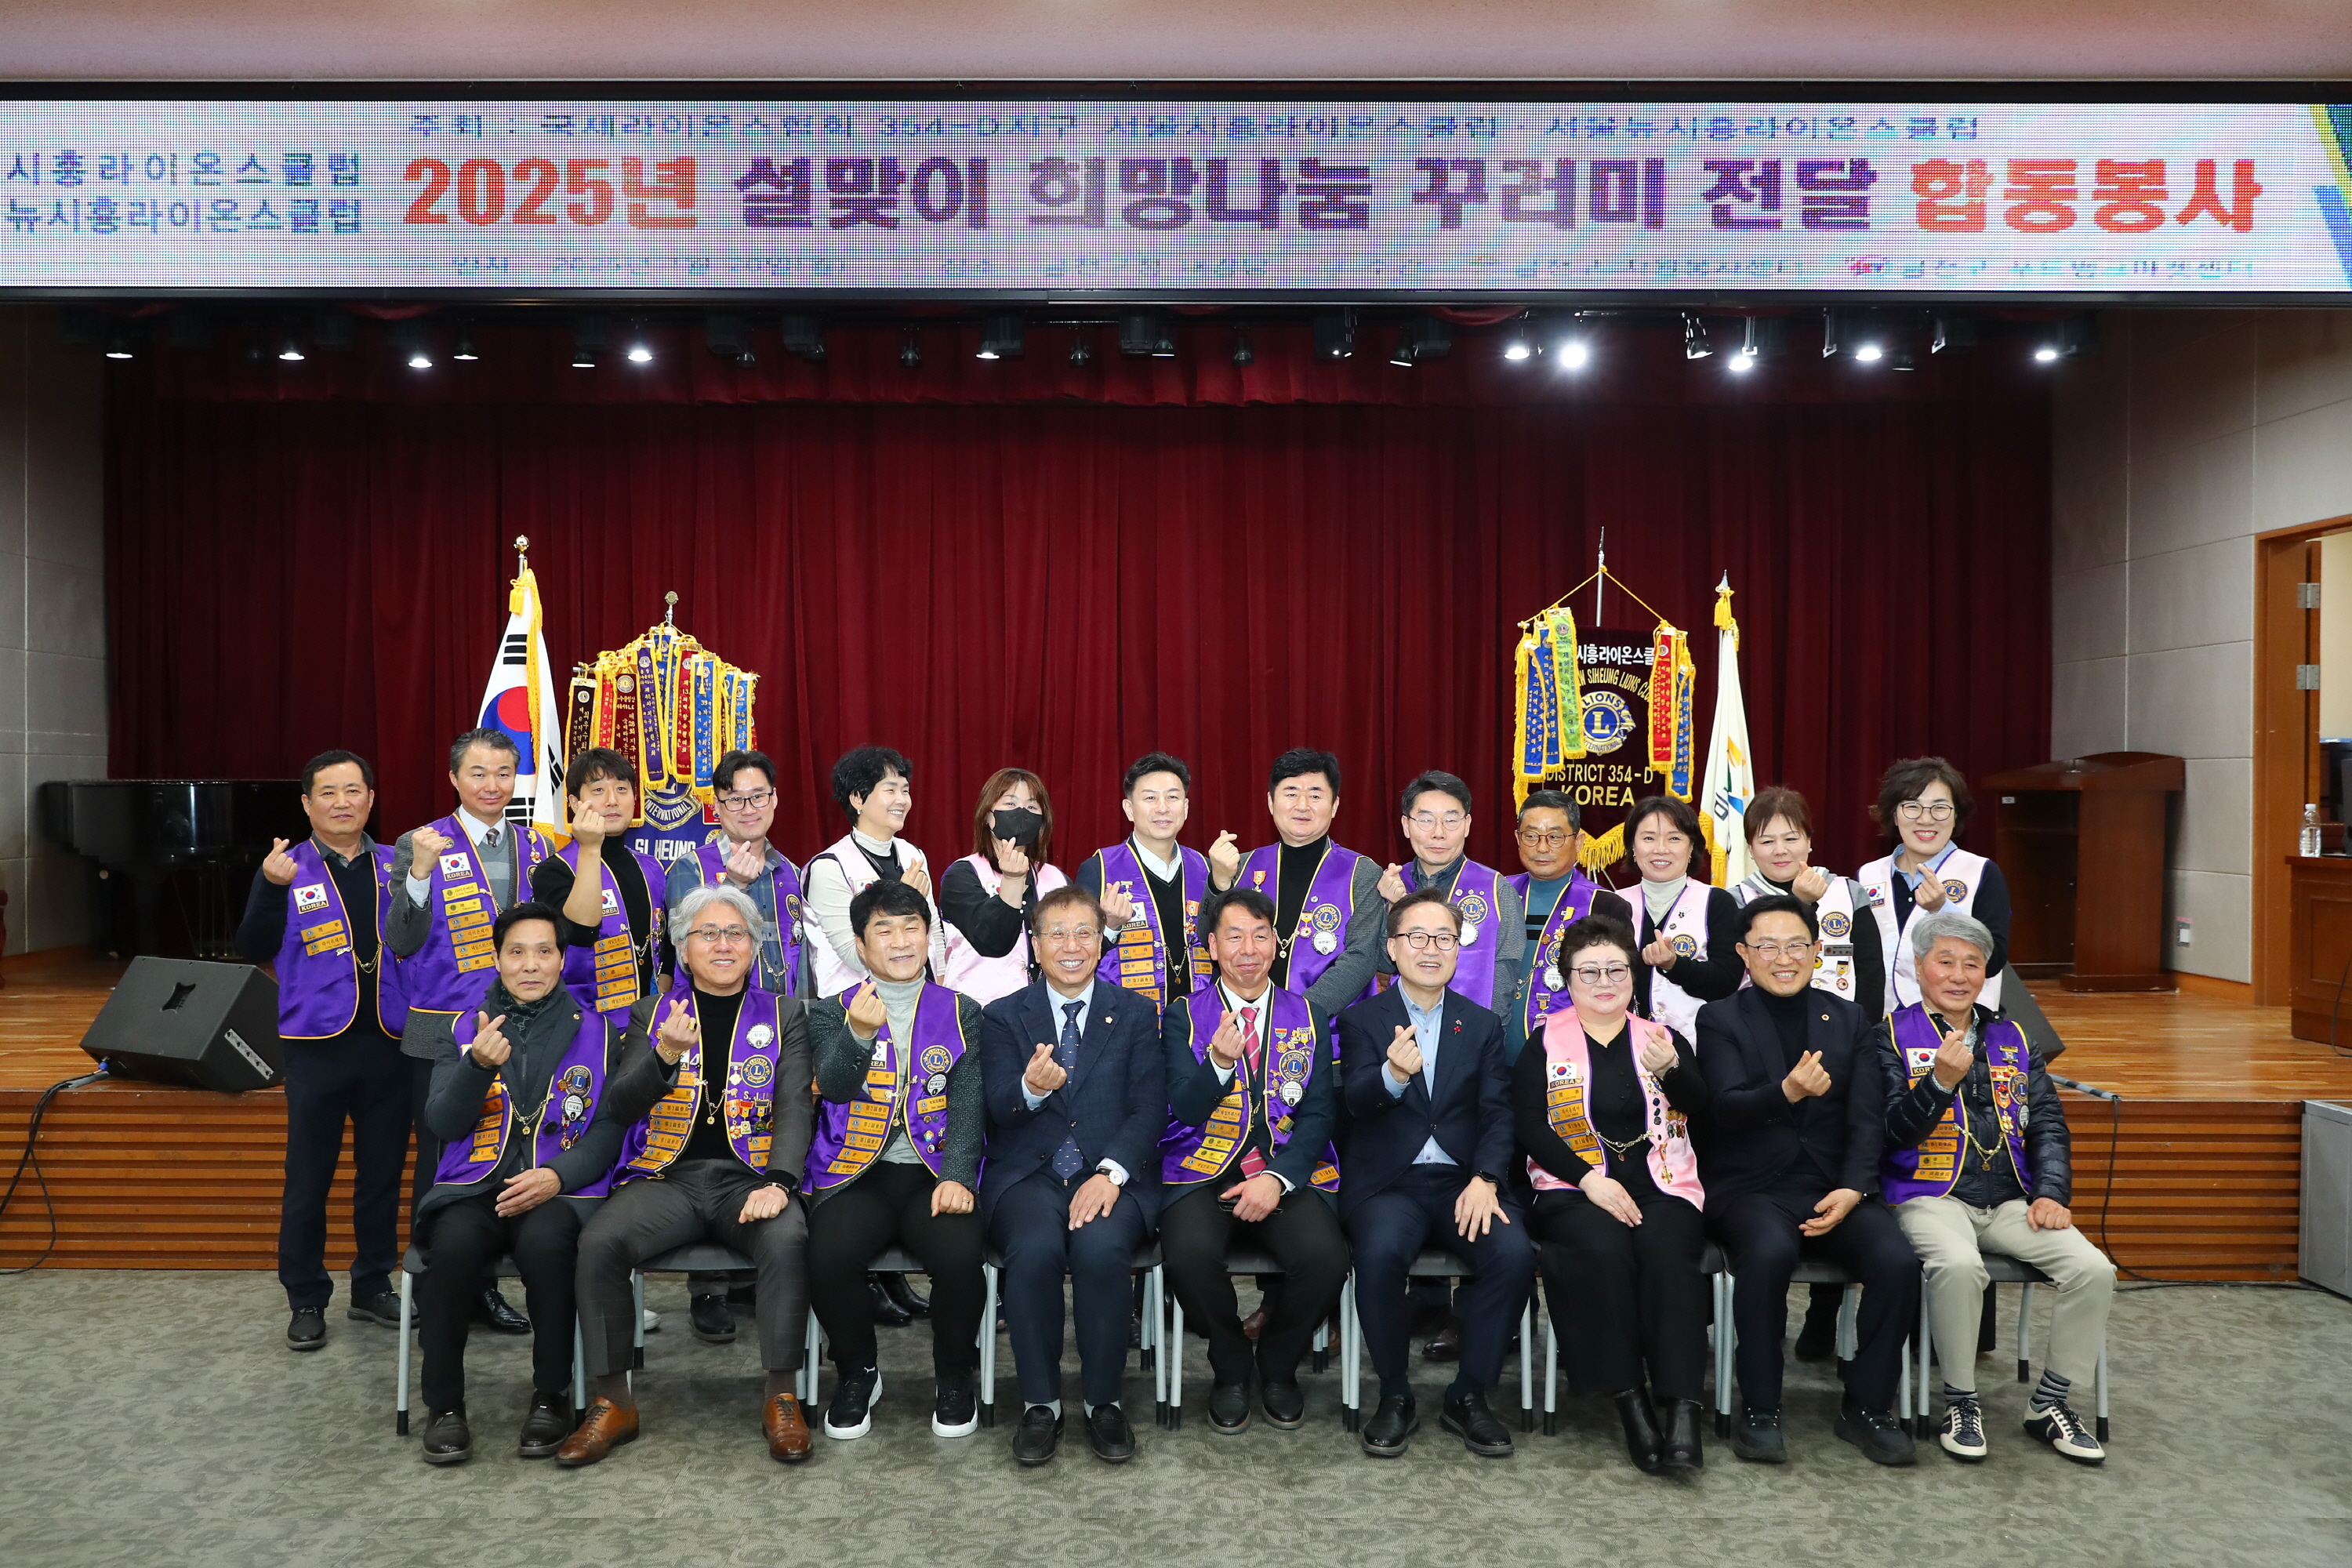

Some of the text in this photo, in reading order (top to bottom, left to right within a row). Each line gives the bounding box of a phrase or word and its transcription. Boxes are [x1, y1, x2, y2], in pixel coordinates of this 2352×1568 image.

[1548, 116, 1978, 140] 서울뉴시흥라이온스클럽
[6, 149, 361, 187] 시흥라이온스클럽
[404, 157, 2263, 234] 2025년 설맞이 희망나눔 꾸러미 전달 합동봉사
[6, 198, 363, 234] 뉴시흥라이온스클럽
[1587, 667, 1620, 685] SIHEUNG
[1619, 671, 1641, 693] LIONS
[1581, 691, 1624, 710] LIONS
[1592, 711, 1610, 734] L
[1584, 740, 1622, 751] TERNATIONAL
[1548, 764, 1605, 782] DISTRICT
[1561, 785, 1635, 806] KOREA
[644, 799, 691, 822] INTERNATIONAL
[446, 870, 470, 880] KOREA
[301, 901, 326, 912] KOREA
[1913, 1065, 1930, 1074] KOR
[1552, 1079, 1574, 1087] KOREA
